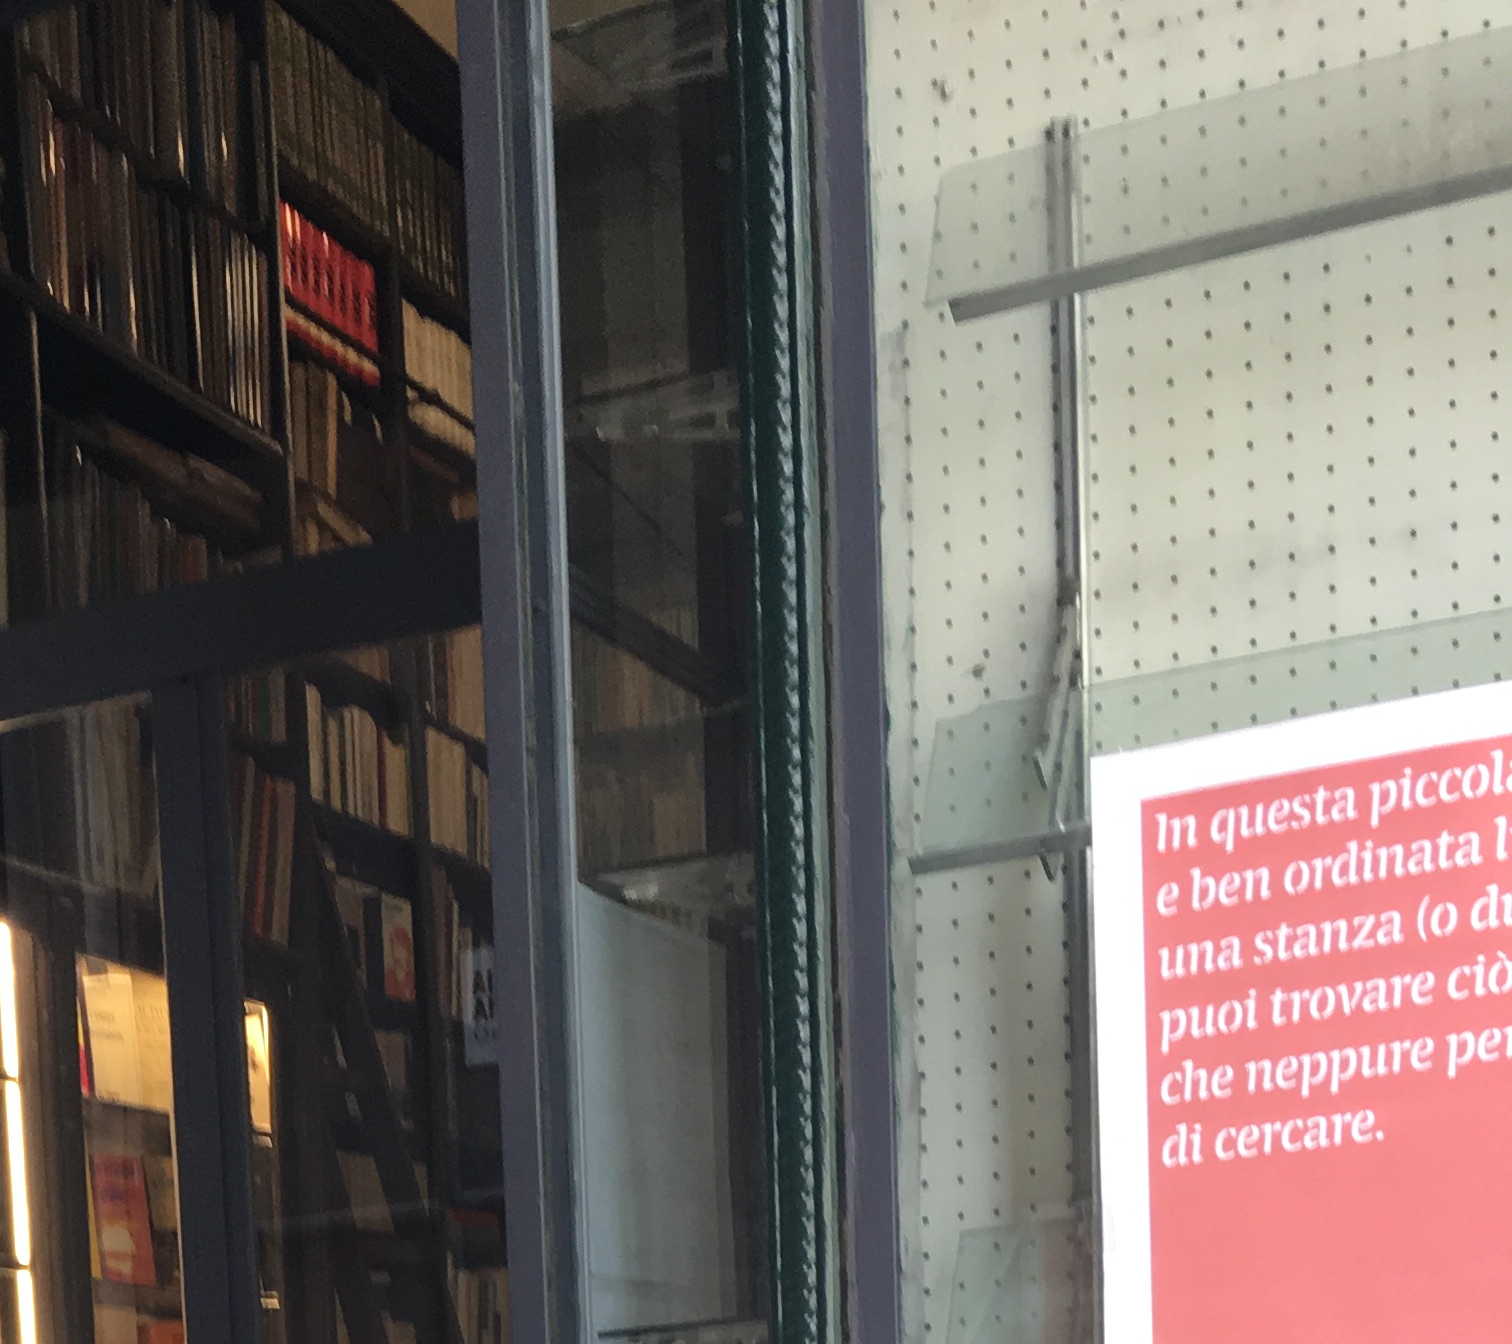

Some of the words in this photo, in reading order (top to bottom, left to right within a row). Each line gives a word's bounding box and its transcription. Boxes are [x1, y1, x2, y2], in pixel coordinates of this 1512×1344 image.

[1155, 811, 1199, 854] In
[1210, 783, 1358, 854] questa
[1368, 748, 1512, 829] piccol
[1156, 881, 1180, 918] e
[1189, 864, 1272, 912] ben
[1284, 829, 1483, 897] ordinata
[1158, 933, 1244, 982] una
[1253, 910, 1404, 966] stanza
[1417, 893, 1458, 945] (o
[1160, 987, 1259, 1057] puoi
[1269, 969, 1435, 1027] trovare
[1160, 1058, 1235, 1107] che
[1245, 1034, 1435, 1100] neppure
[1162, 1122, 1203, 1170] di
[1214, 1107, 1385, 1165] cercare.
